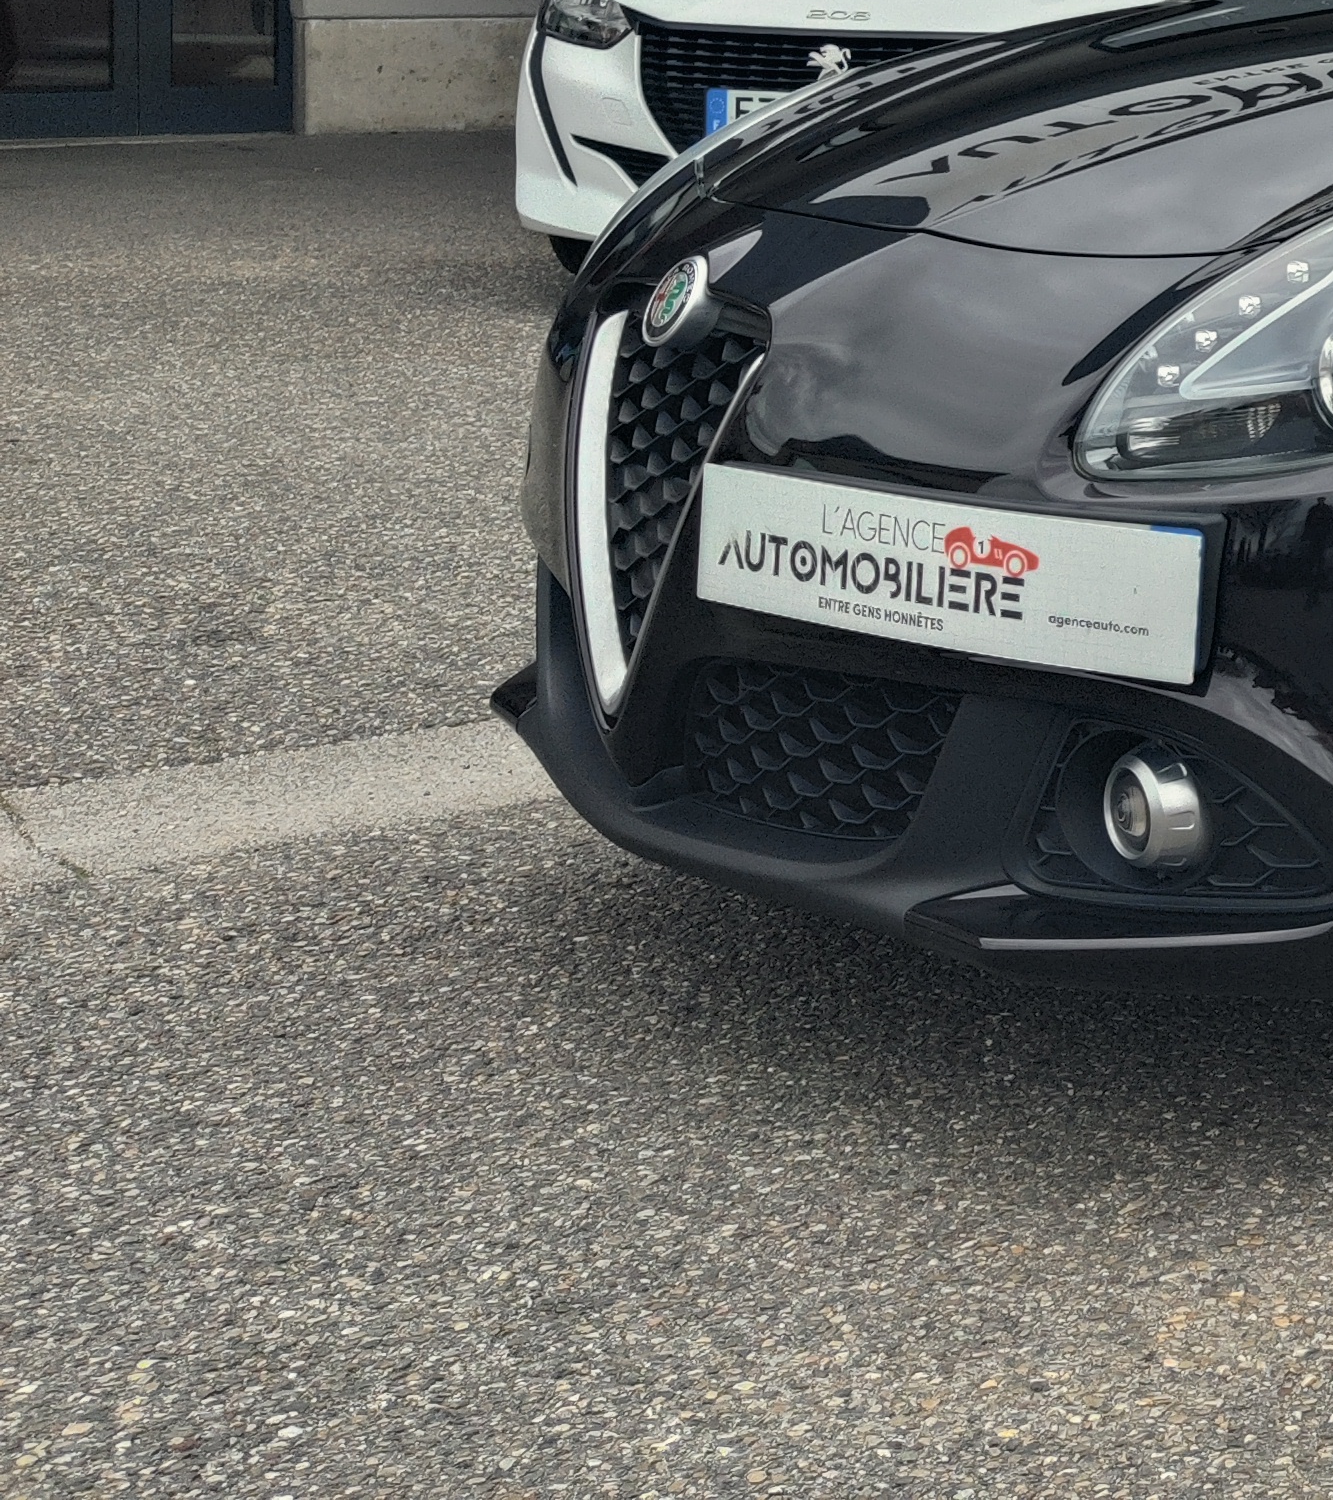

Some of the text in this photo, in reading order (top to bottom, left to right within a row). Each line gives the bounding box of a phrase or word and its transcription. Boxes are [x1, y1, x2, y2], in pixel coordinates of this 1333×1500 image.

[806, 9, 871, 22] 208
[820, 503, 946, 555] L'AGENCE
[718, 530, 1026, 621] AUTOMOBILIERE
[818, 596, 944, 632] ENTRE GENS HONNÊTES
[1047, 612, 1150, 637] agenceauto.com
